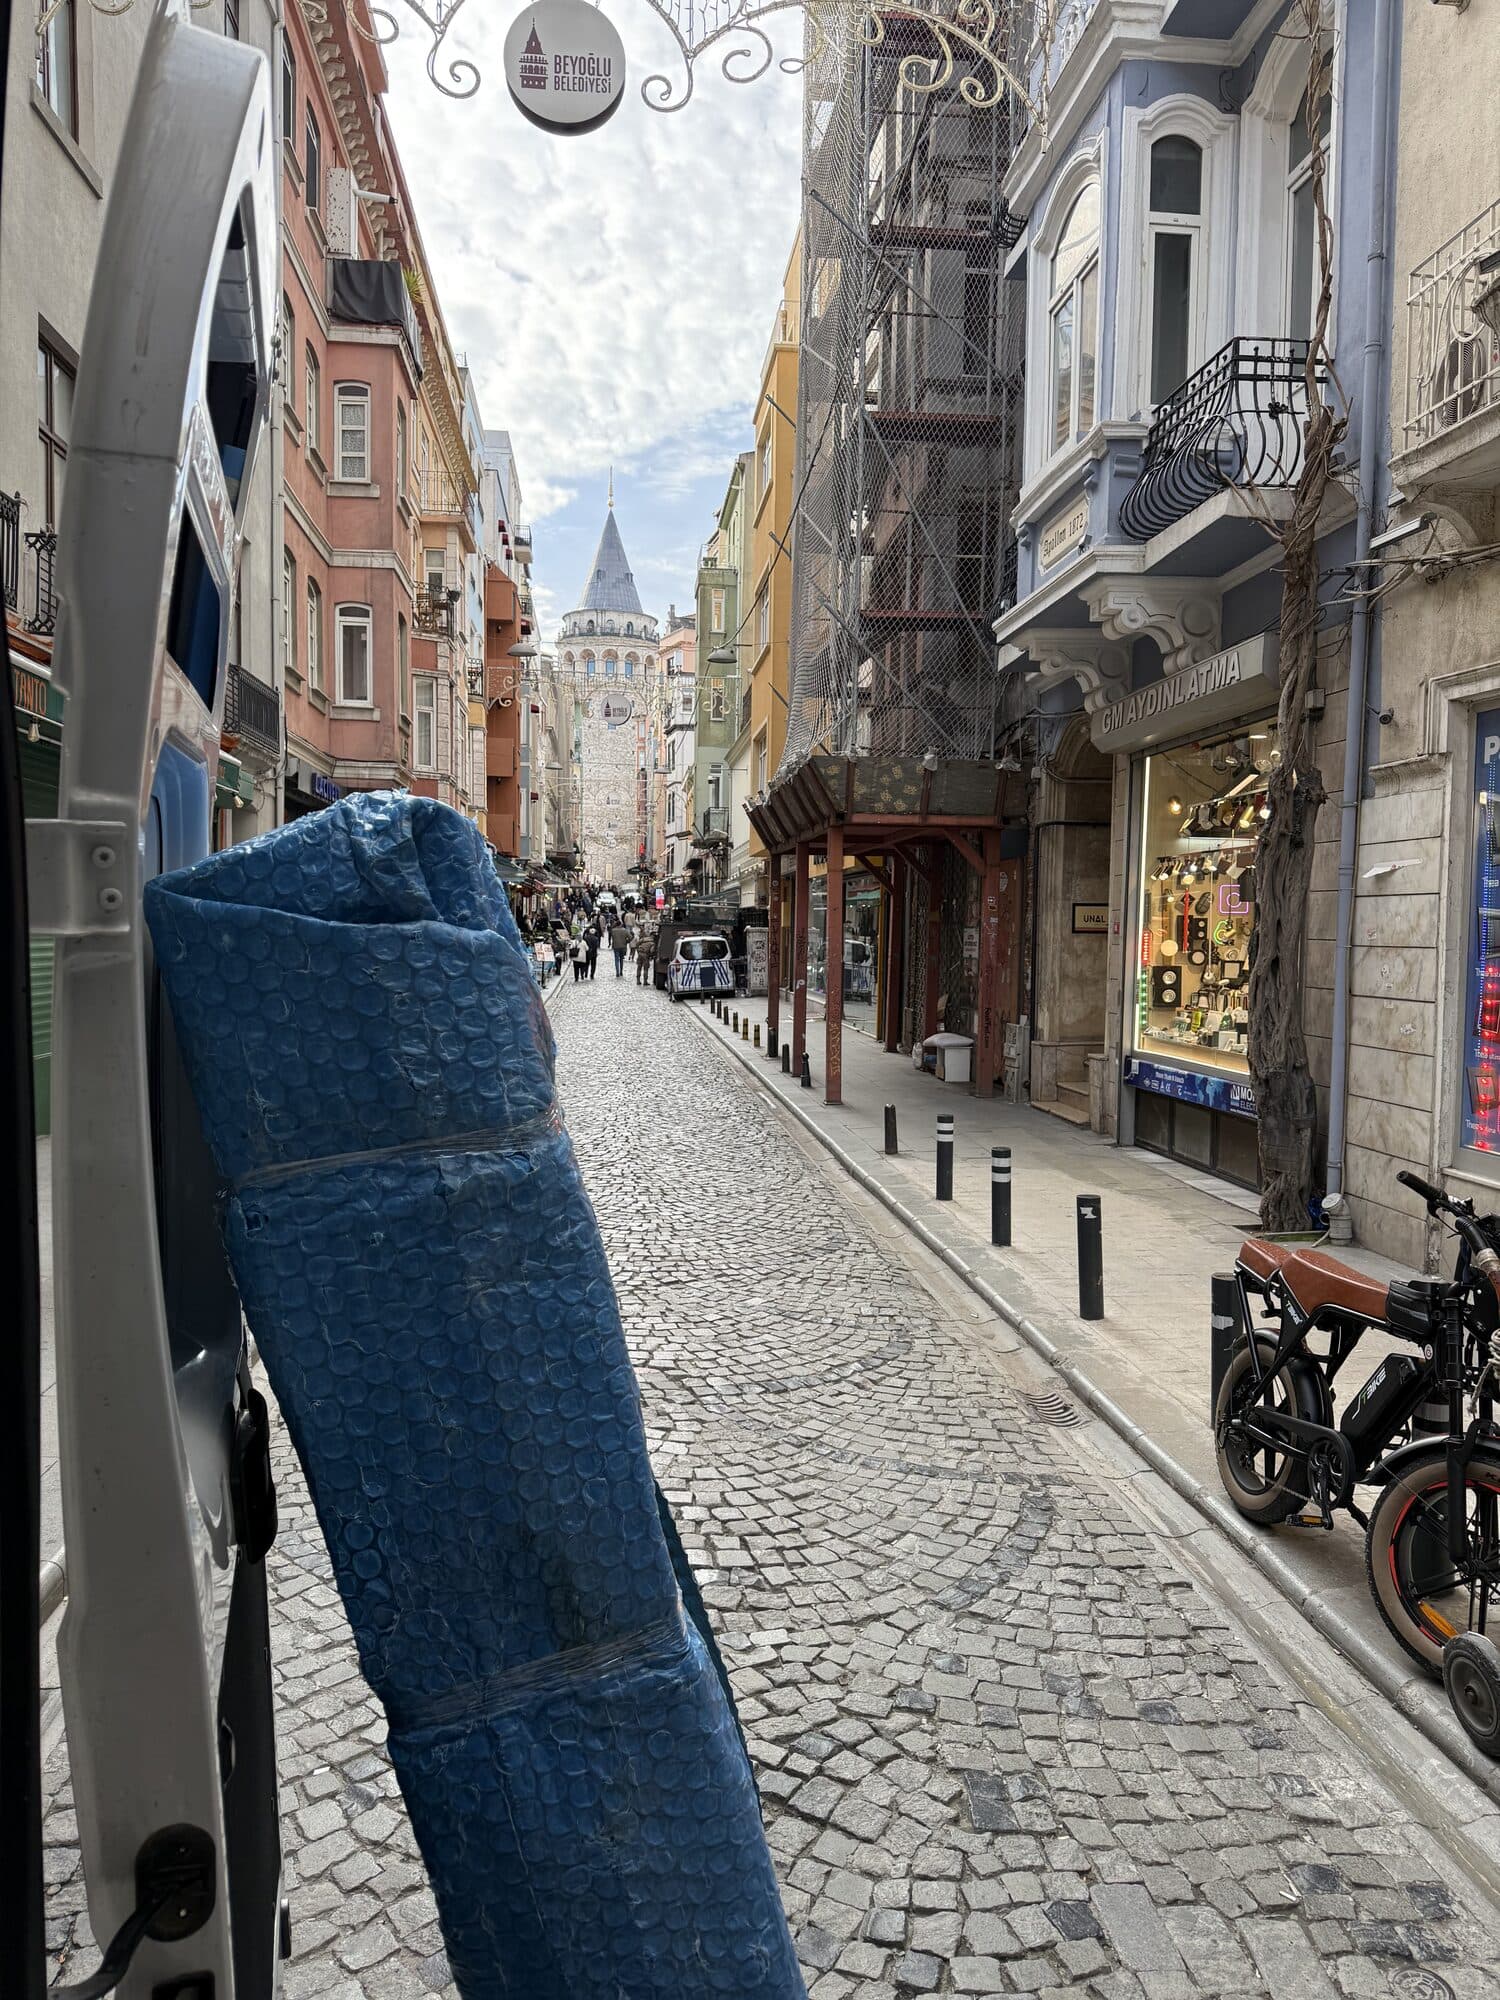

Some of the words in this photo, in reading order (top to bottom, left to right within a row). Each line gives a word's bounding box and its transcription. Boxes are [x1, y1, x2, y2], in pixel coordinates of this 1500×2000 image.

[554, 53, 611, 77] BEYOĞLU
[554, 76, 611, 93] BELEDİYESİ
[1069, 512, 1084, 537] 1872
[1103, 704, 1123, 734] GM
[1127, 651, 1241, 724] AYDINLATMA
